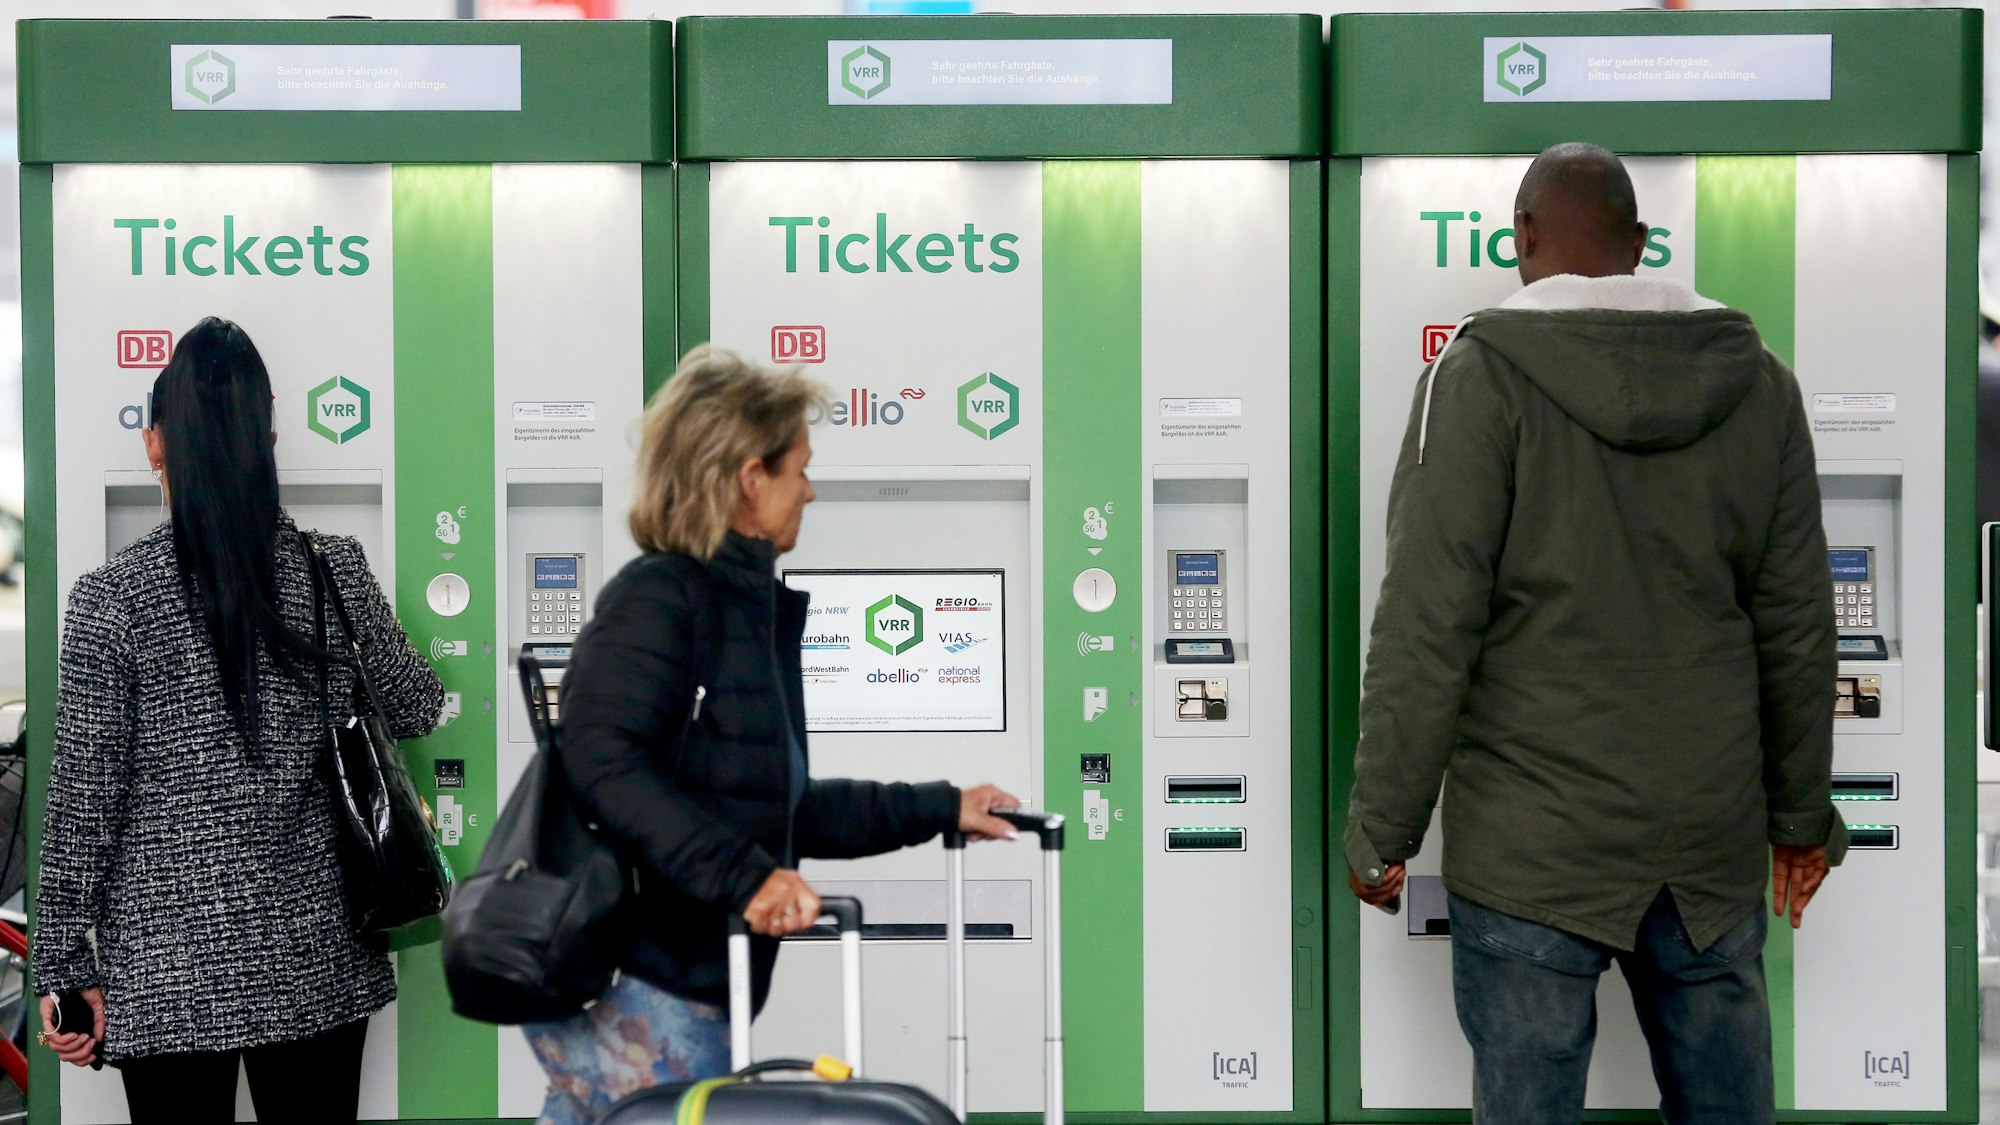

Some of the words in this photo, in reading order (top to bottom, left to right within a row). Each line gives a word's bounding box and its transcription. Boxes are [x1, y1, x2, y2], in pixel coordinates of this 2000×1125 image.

[932, 60, 956, 72] Sehr
[959, 60, 998, 72] geehrte
[1001, 60, 1055, 72] Fahrgäste,
[1588, 57, 1612, 68] Sehr
[1615, 57, 1654, 68] geehrte
[1657, 57, 1712, 68] Fahrgäste,
[278, 66, 302, 77] Sehr
[305, 66, 344, 77] geehrte
[348, 66, 402, 77] Fahrgäste,
[852, 67, 880, 78] VRR
[1508, 64, 1535, 75] VRR
[197, 71, 224, 83] VRR
[932, 74, 955, 86] bitte
[958, 74, 1005, 86] beachten
[1008, 74, 1024, 86] Sie
[1028, 74, 1043, 86] die
[1046, 74, 1101, 86] Aushänge.
[1588, 70, 1611, 82] bitte
[1614, 70, 1662, 82] beachten
[1665, 70, 1681, 82] Sie
[1684, 70, 1700, 82] die
[1702, 70, 1758, 82] Aushänge.
[278, 79, 301, 91] bitte
[304, 79, 352, 91] beachten
[355, 79, 371, 91] Sie
[374, 79, 391, 91] die
[394, 79, 449, 91] Aushänge.
[114, 215, 370, 276] Tickets
[769, 213, 1020, 273] Tickets
[1420, 211, 1672, 268] Tics
[124, 336, 166, 362] DB
[778, 332, 819, 358] DB
[322, 404, 356, 417] VRR
[808, 387, 904, 428] ellio
[971, 400, 1005, 413] VRR
[807, 606, 822, 616] gio
[826, 606, 850, 614] NRW
[878, 620, 910, 631] VRR
[801, 634, 850, 644] urobahn
[938, 632, 972, 642] VIAS
[866, 668, 920, 684] abellio
[938, 666, 980, 676] national
[938, 675, 980, 686] express
[444, 814, 452, 824] 20
[1090, 808, 1098, 818] 20
[448, 830, 456, 840] 10
[1095, 824, 1103, 836] 10
